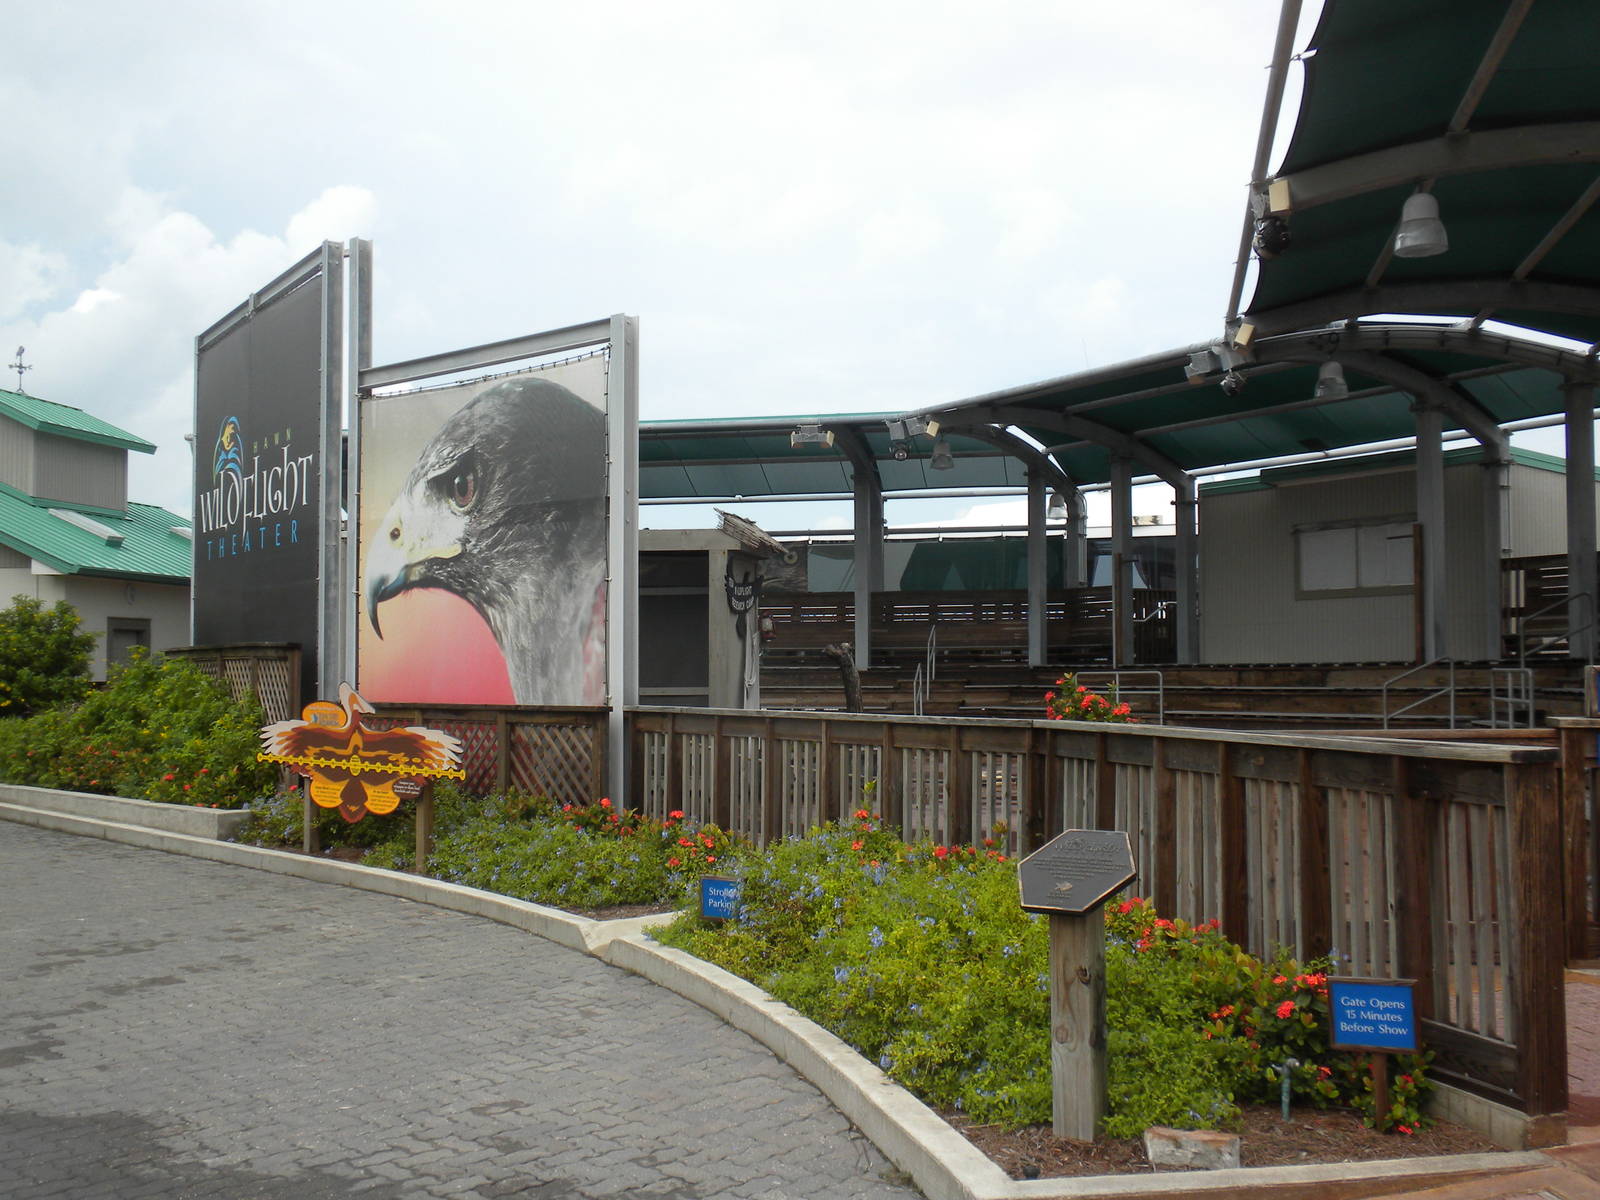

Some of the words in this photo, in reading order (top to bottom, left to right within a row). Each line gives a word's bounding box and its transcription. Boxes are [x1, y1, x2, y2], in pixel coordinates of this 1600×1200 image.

[253, 427, 292, 453] HAWN
[207, 519, 298, 560] THEATER
[1340, 996, 1366, 1007] Gate
[1369, 998, 1406, 1010] Opens
[1346, 1010, 1357, 1020] 15
[1360, 1011, 1403, 1022] Minutes
[1340, 1022, 1374, 1033] Before
[1378, 1024, 1408, 1035] Show
